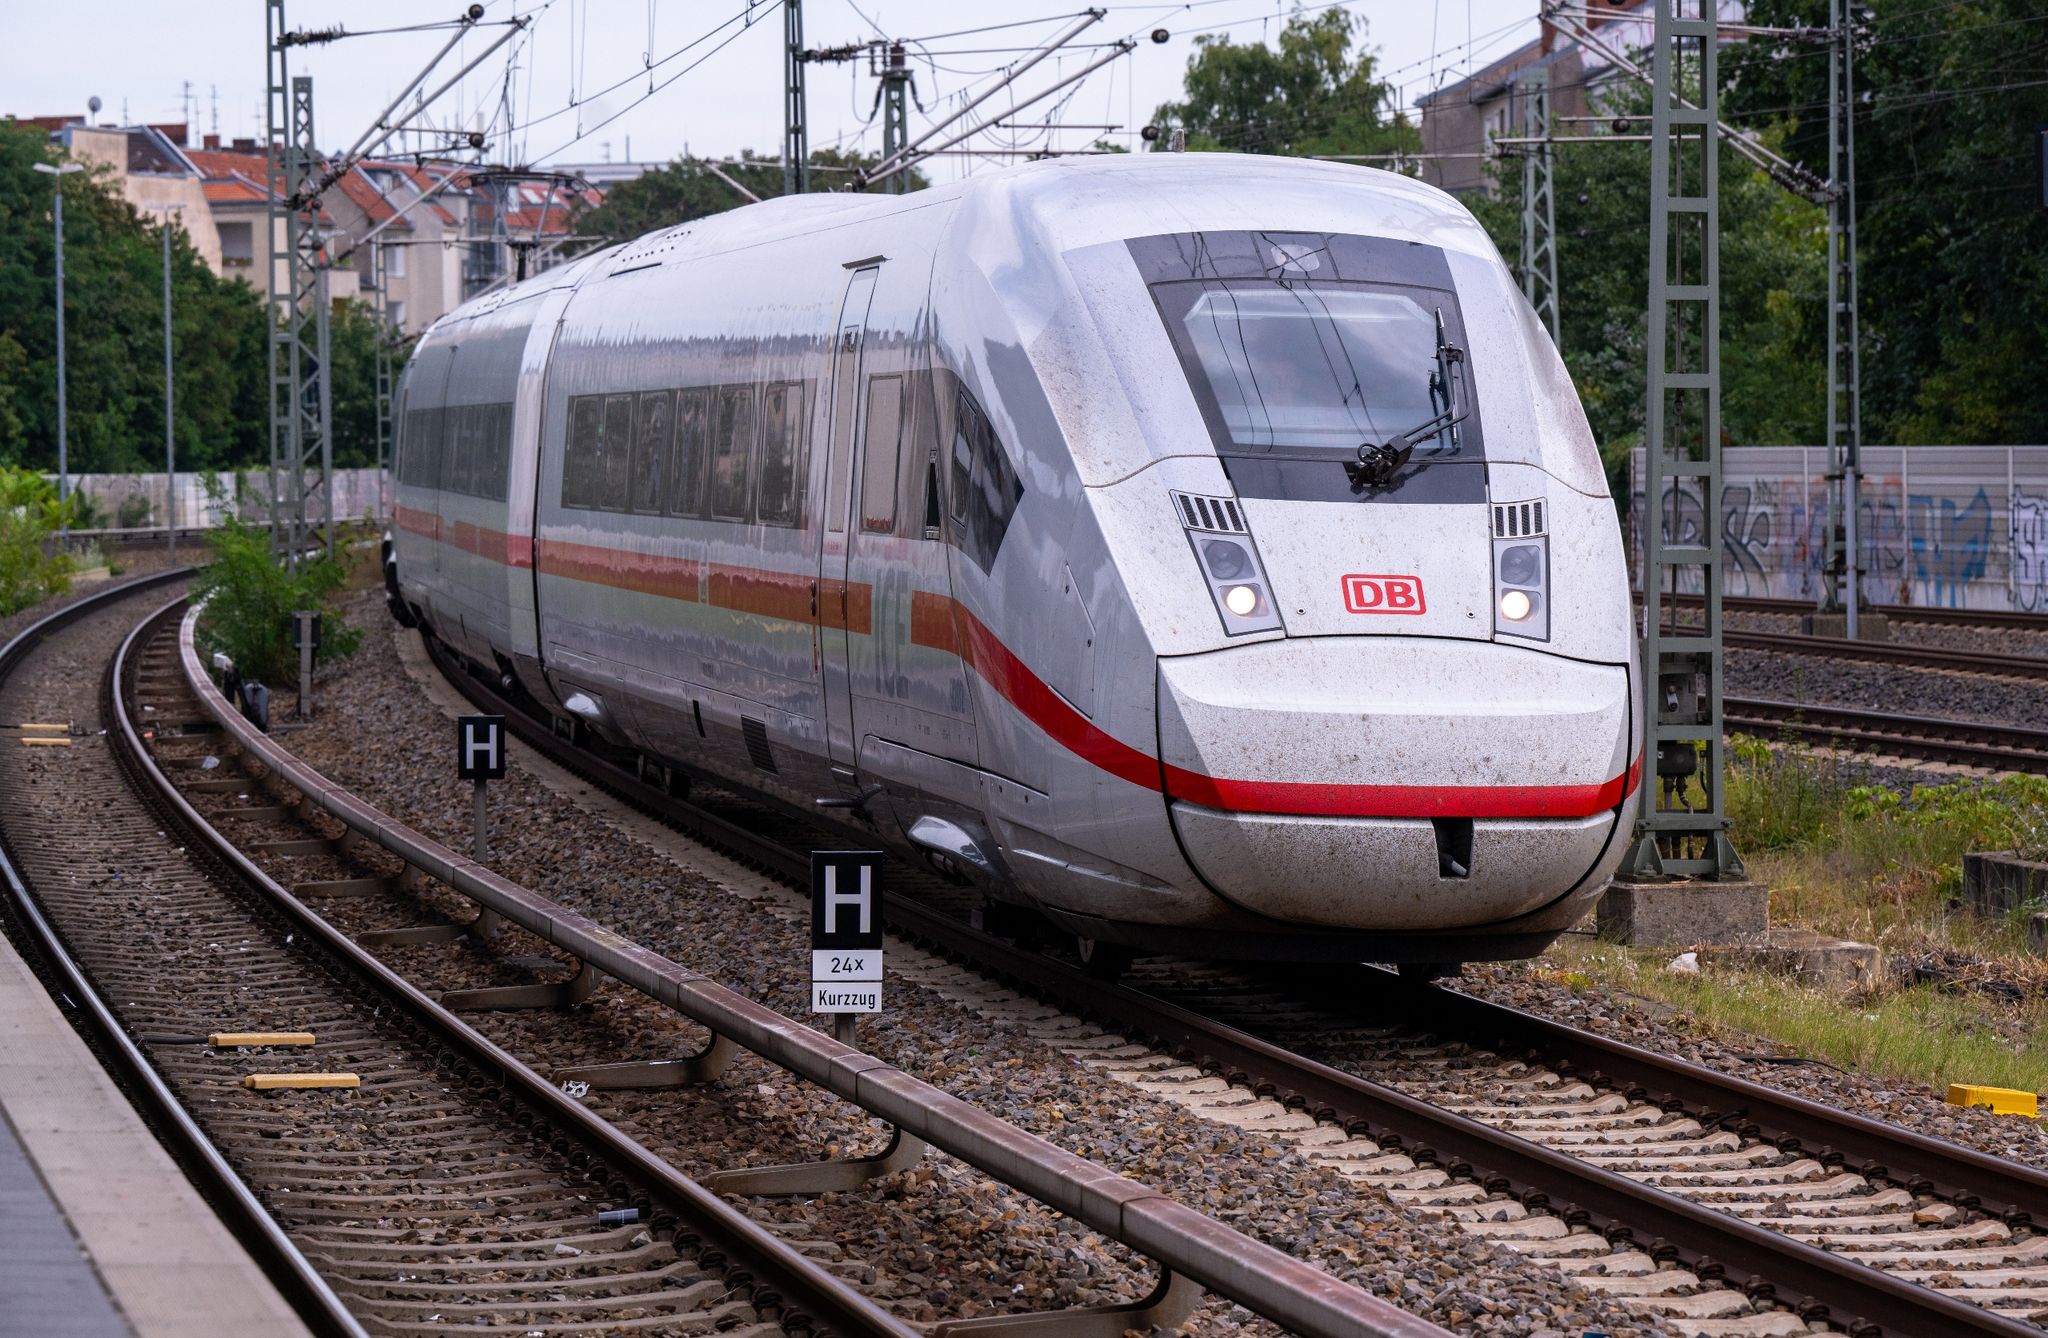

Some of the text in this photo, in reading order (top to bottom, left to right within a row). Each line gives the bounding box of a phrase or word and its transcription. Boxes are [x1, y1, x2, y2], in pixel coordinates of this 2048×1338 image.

[1350, 579, 1417, 609] DB
[465, 723, 498, 770] H
[824, 864, 872, 934] H
[831, 957, 865, 974] 24x
[818, 989, 876, 1010] Kurzzug
